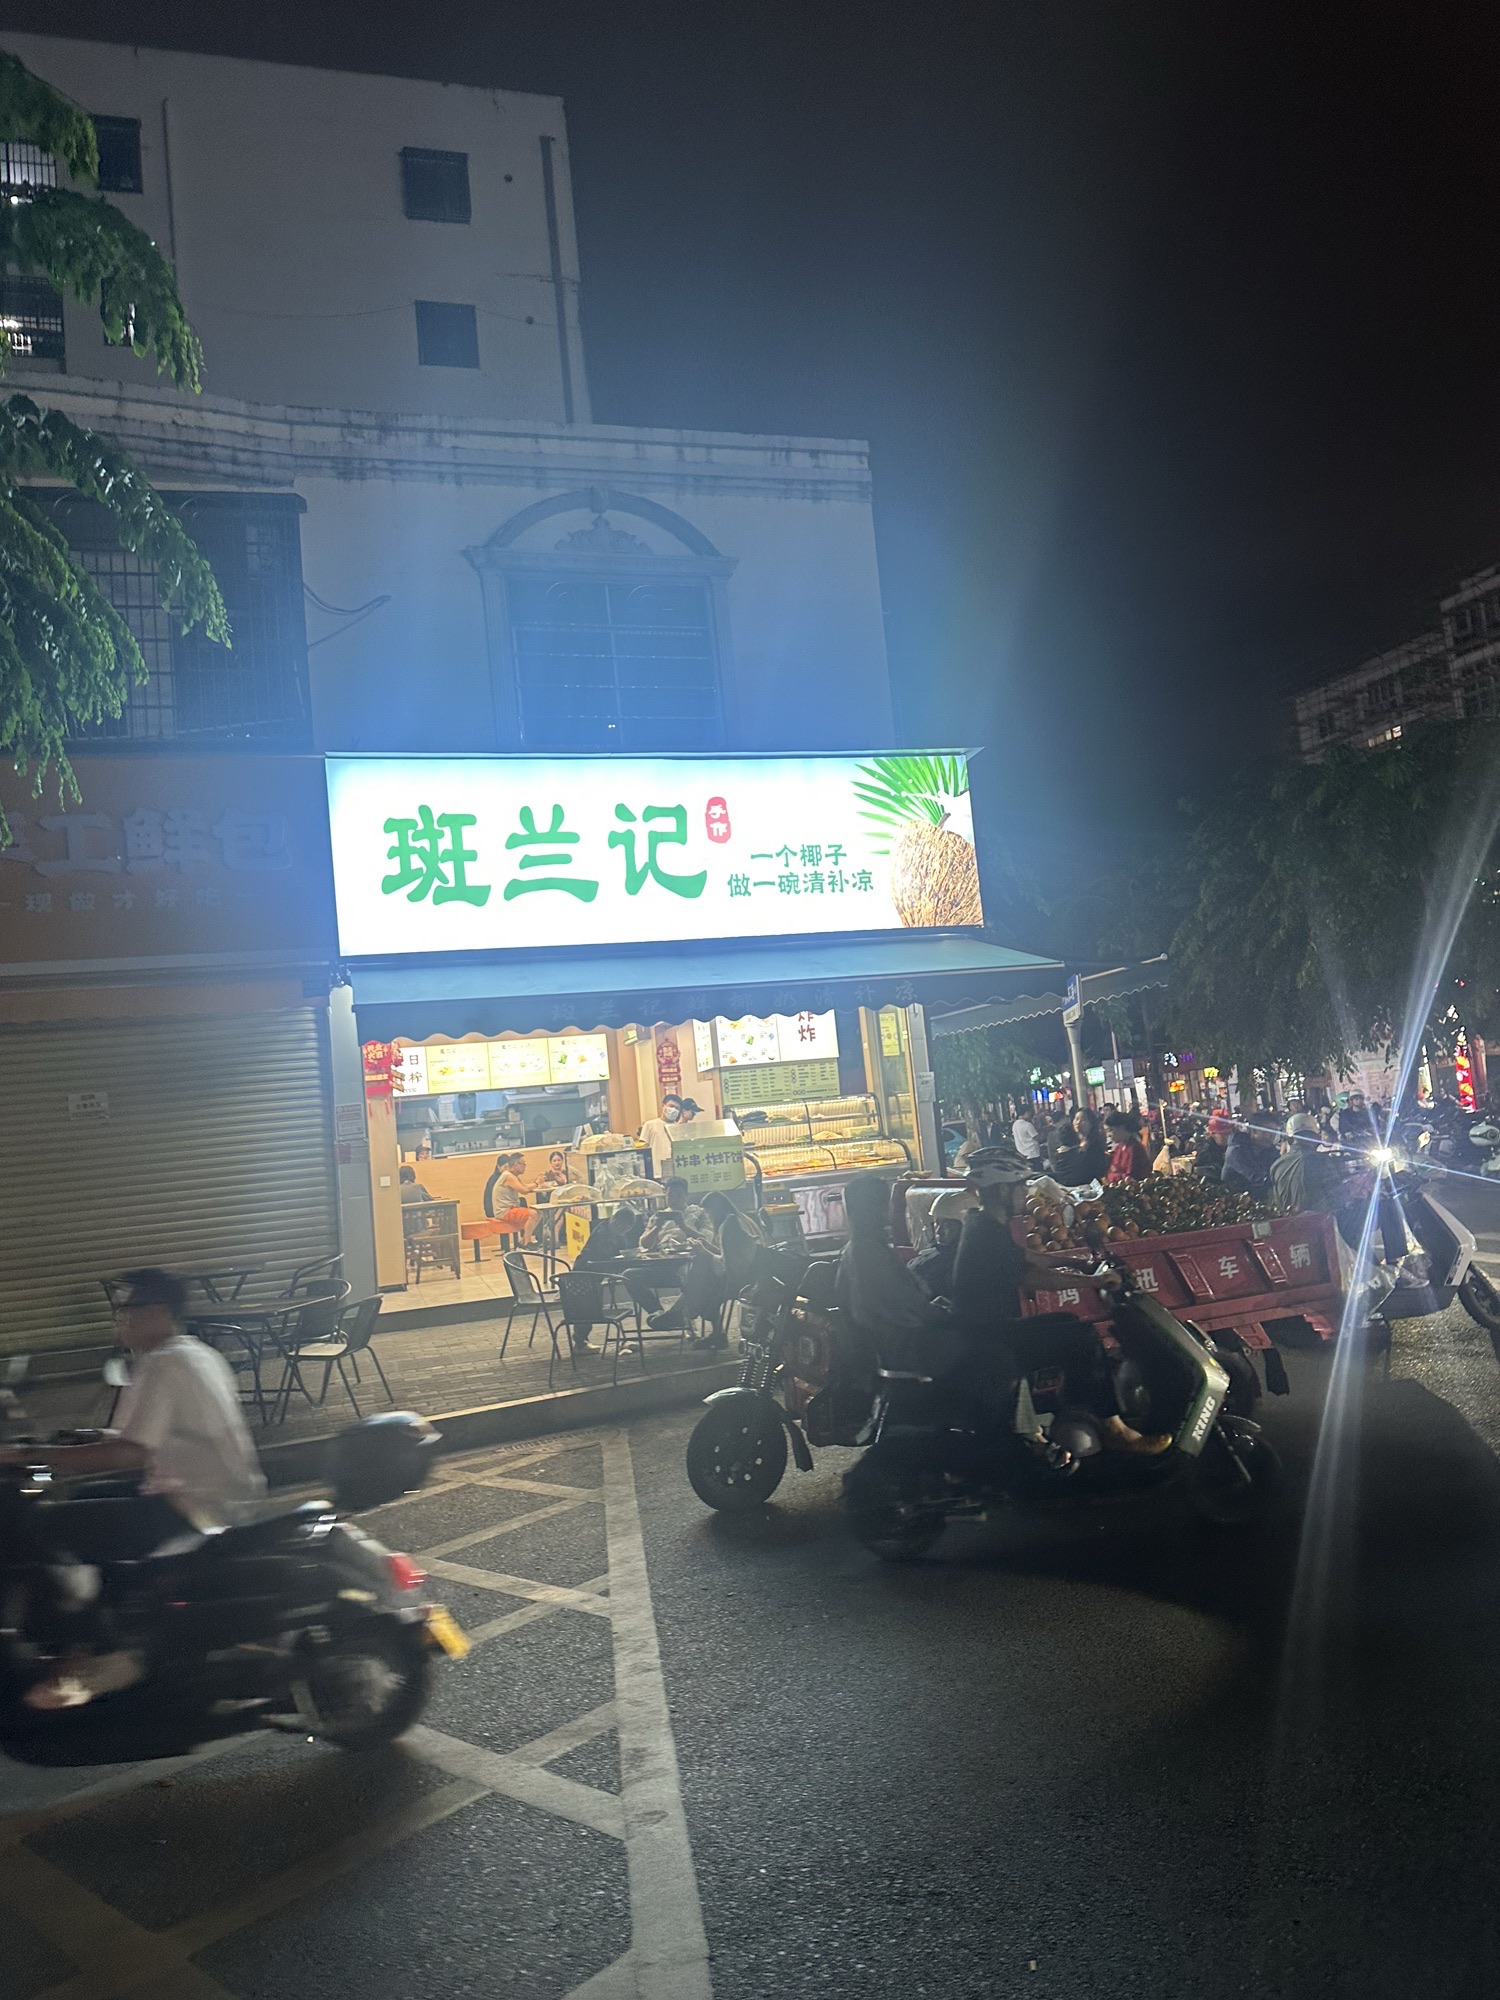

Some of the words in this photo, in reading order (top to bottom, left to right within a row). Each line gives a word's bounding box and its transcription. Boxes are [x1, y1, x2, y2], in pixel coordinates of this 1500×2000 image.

[707, 802, 728, 839] 手作
[381, 803, 707, 907] 斑兰记
[750, 843, 847, 868] 一个椰子
[727, 868, 874, 897] 做一碗清补凉
[1192, 1396, 1216, 1441] KING
